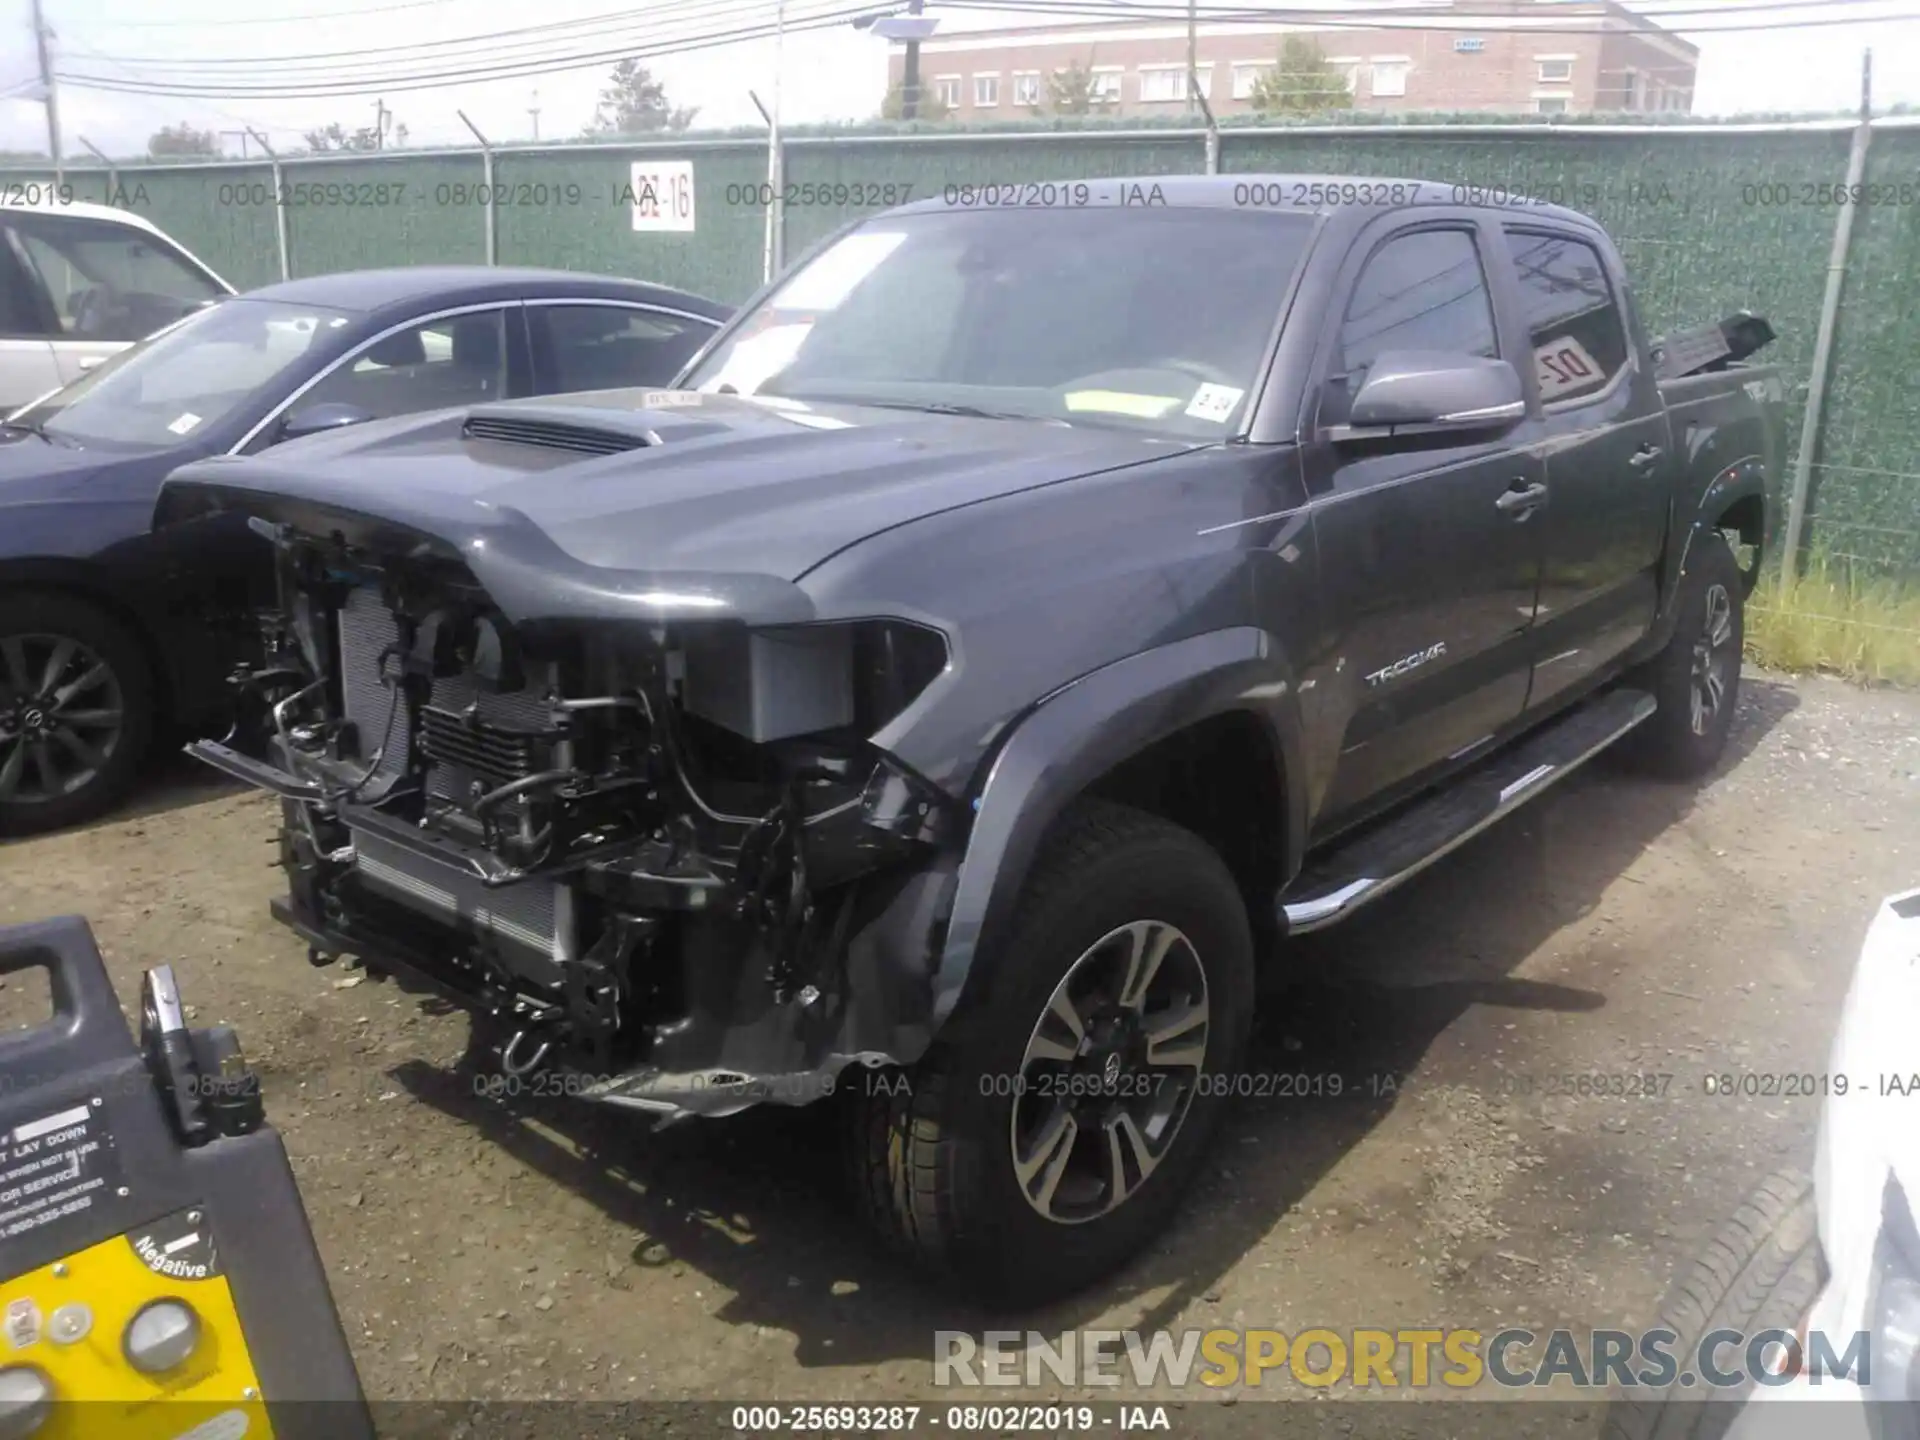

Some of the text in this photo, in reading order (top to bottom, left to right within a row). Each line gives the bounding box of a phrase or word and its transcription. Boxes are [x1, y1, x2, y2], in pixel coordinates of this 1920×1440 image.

[1363, 640, 1447, 687] TACOMA
[14, 1140, 41, 1159] LAY
[46, 1124, 87, 1148] DOWN
[135, 1234, 207, 1278] Negative
